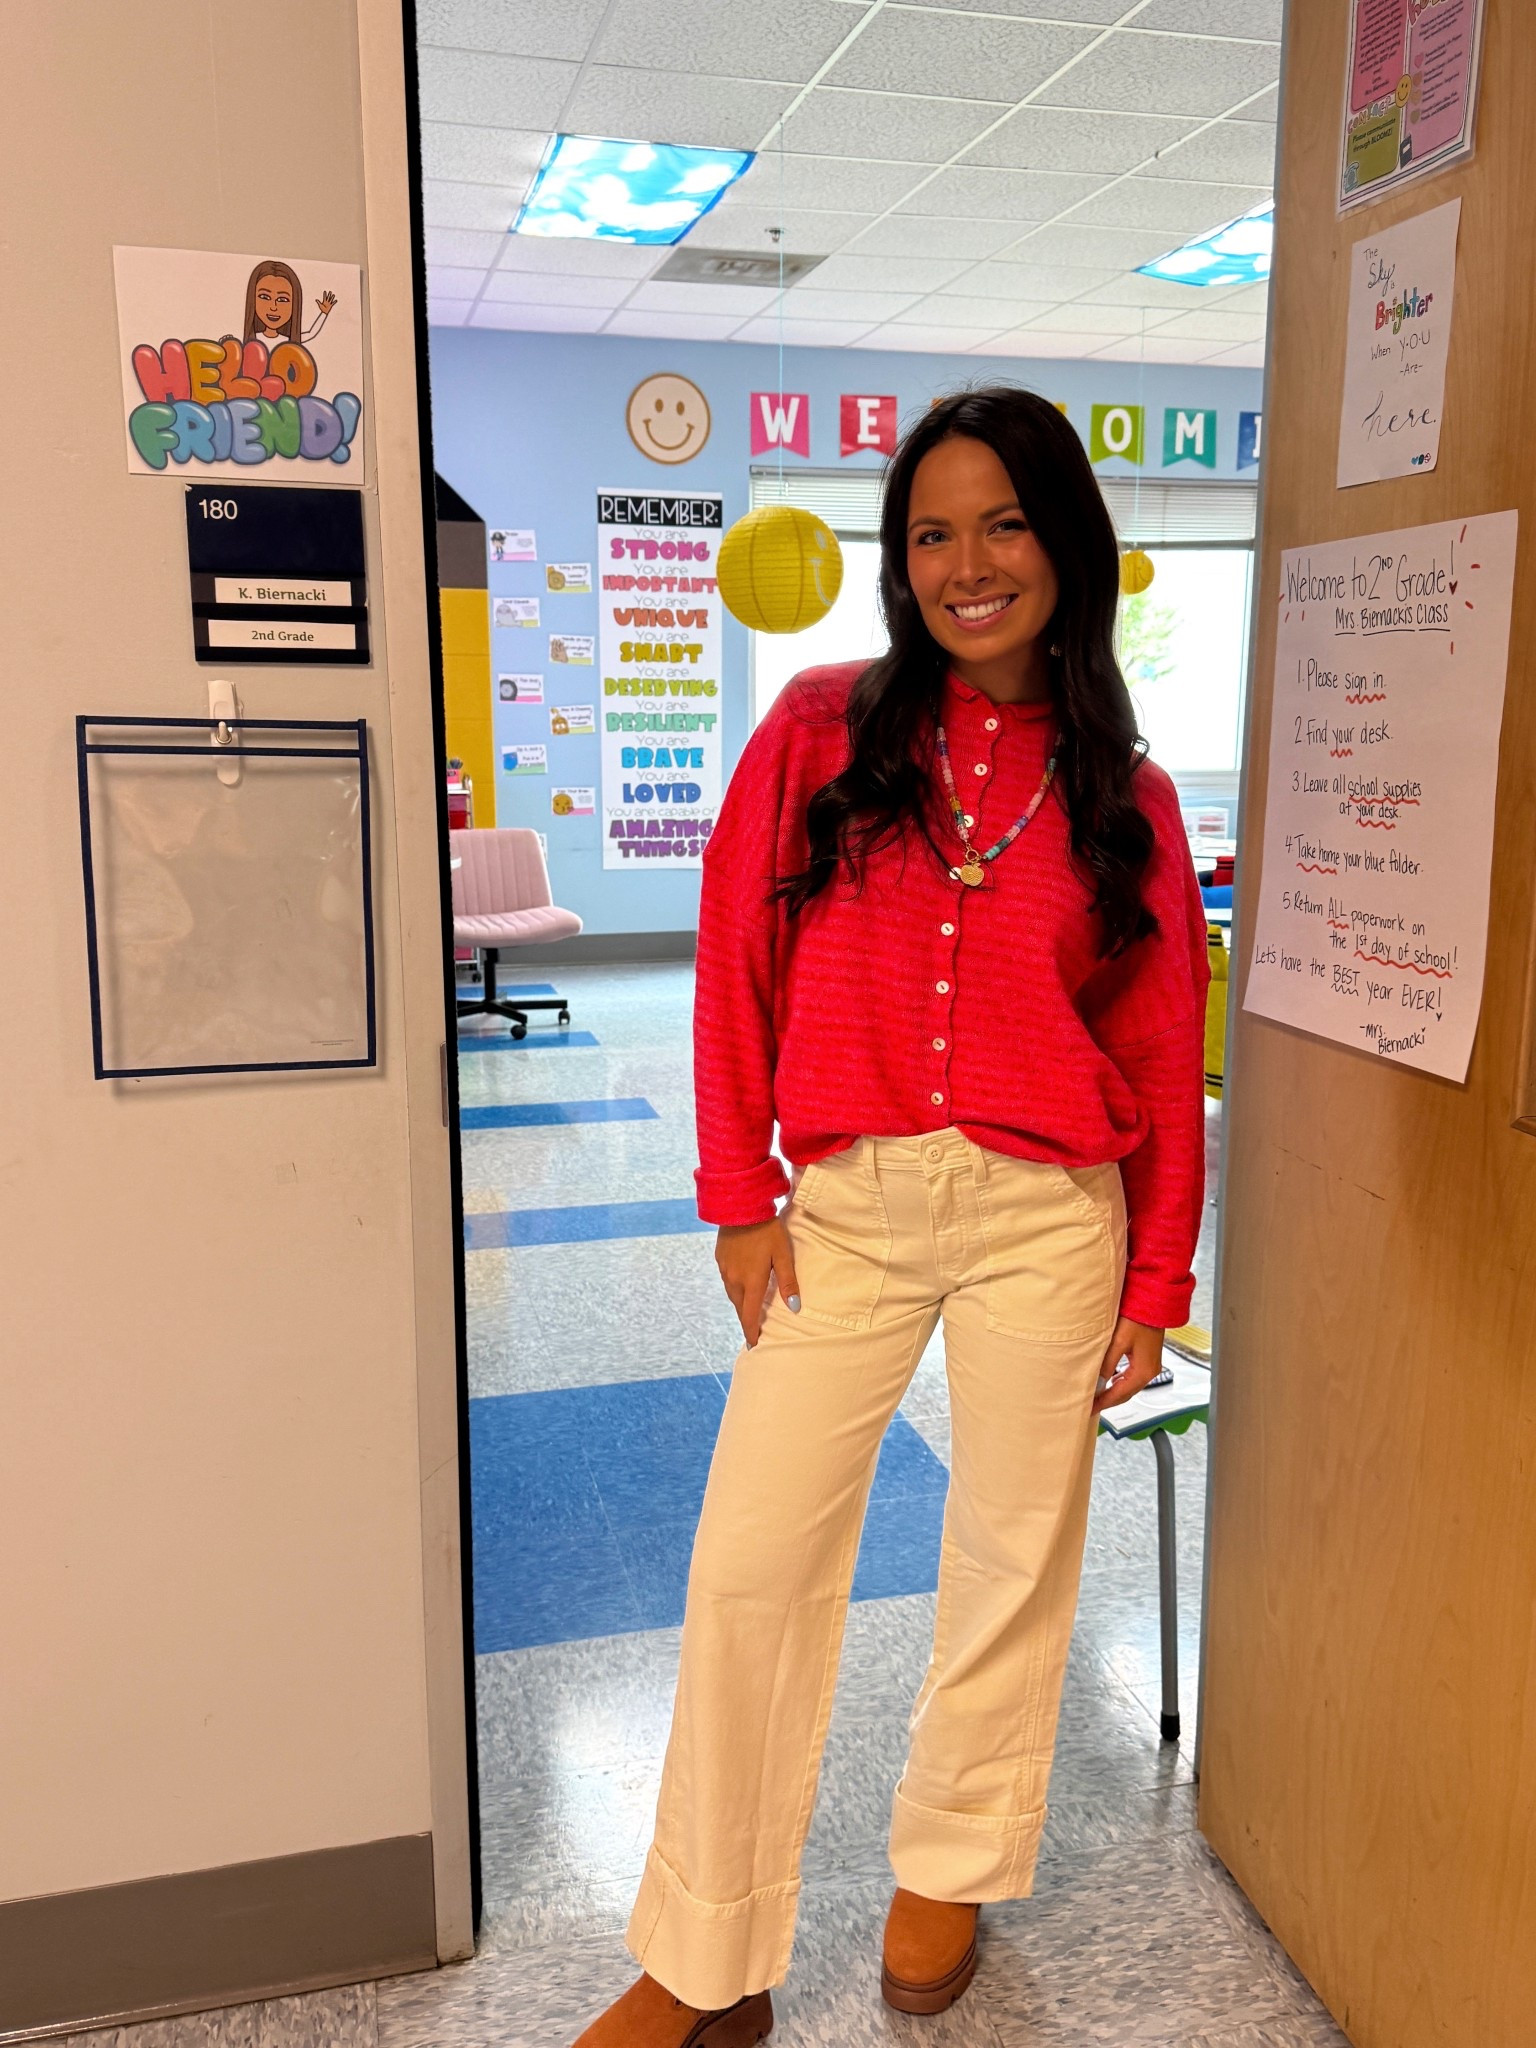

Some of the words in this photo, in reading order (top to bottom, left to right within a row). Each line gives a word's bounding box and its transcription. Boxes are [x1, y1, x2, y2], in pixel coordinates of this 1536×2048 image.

[1367, 258, 1395, 297] Sky
[1375, 287, 1433, 335] Brighter
[1371, 344, 1391, 361] When
[131, 338, 318, 406] HELLO
[129, 391, 361, 470] FRIEND!
[198, 498, 238, 520] 180
[600, 495, 719, 526] REMEMBER:
[633, 528, 662, 539] You
[665, 530, 688, 541] are
[610, 537, 710, 561] STRONG
[633, 563, 662, 575] You
[665, 565, 688, 576] are
[1287, 557, 1346, 604] Welcome
[1351, 555, 1367, 601] to
[238, 587, 252, 600] K.
[256, 587, 327, 601] Biernacki
[602, 574, 718, 594] IMPORTANT
[634, 595, 662, 607] You
[665, 597, 688, 608] are
[613, 607, 708, 629] UNIQUE
[1335, 606, 1360, 630] Mrs.
[1416, 602, 1449, 624] Class
[251, 630, 275, 641] 2nd
[278, 631, 314, 642] Grade
[635, 630, 663, 642] You
[666, 632, 689, 643] are
[619, 641, 703, 663] SMART
[635, 666, 663, 677] You
[666, 667, 689, 678] are
[1307, 658, 1338, 692] Please
[1344, 671, 1367, 697] sign
[604, 677, 718, 697] DESERVING
[636, 700, 663, 711] You
[666, 701, 689, 712] are
[605, 712, 717, 733] RESILIENT
[636, 735, 663, 746] You
[666, 736, 689, 747] are
[1306, 718, 1328, 745] Find
[1333, 726, 1356, 752] your
[1360, 719, 1394, 745] desk.
[621, 747, 704, 769] BRAVE
[636, 771, 664, 782] You
[667, 772, 689, 782] are
[1303, 772, 1329, 793] Leave
[1332, 774, 1346, 794] all
[1348, 775, 1378, 797] school
[623, 783, 702, 804] LOVED
[657, 806, 699, 819] capable
[1339, 802, 1352, 816] at
[1356, 804, 1376, 823] your
[1378, 801, 1402, 819] desk.
[609, 818, 714, 839] AMAZING
[1294, 834, 1316, 859] Take
[1318, 839, 1340, 866] home
[1343, 850, 1362, 873] your
[1364, 848, 1385, 873] blue
[1388, 848, 1424, 875] folder.
[1293, 890, 1323, 916] Return
[1328, 896, 1347, 919] ALL
[1350, 909, 1405, 932] paperwork
[1411, 921, 1425, 936] on
[1329, 930, 1347, 950] the
[1371, 937, 1391, 963] day
[1398, 945, 1410, 960] of
[1414, 945, 1458, 970] school!
[1255, 943, 1277, 965] Let's
[1280, 948, 1302, 972] have
[1309, 958, 1326, 978] the
[1332, 964, 1361, 987] BEST
[1366, 980, 1394, 1006] year
[1400, 983, 1442, 1020] EVER!
[1378, 1026, 1427, 1055] Biernacki
